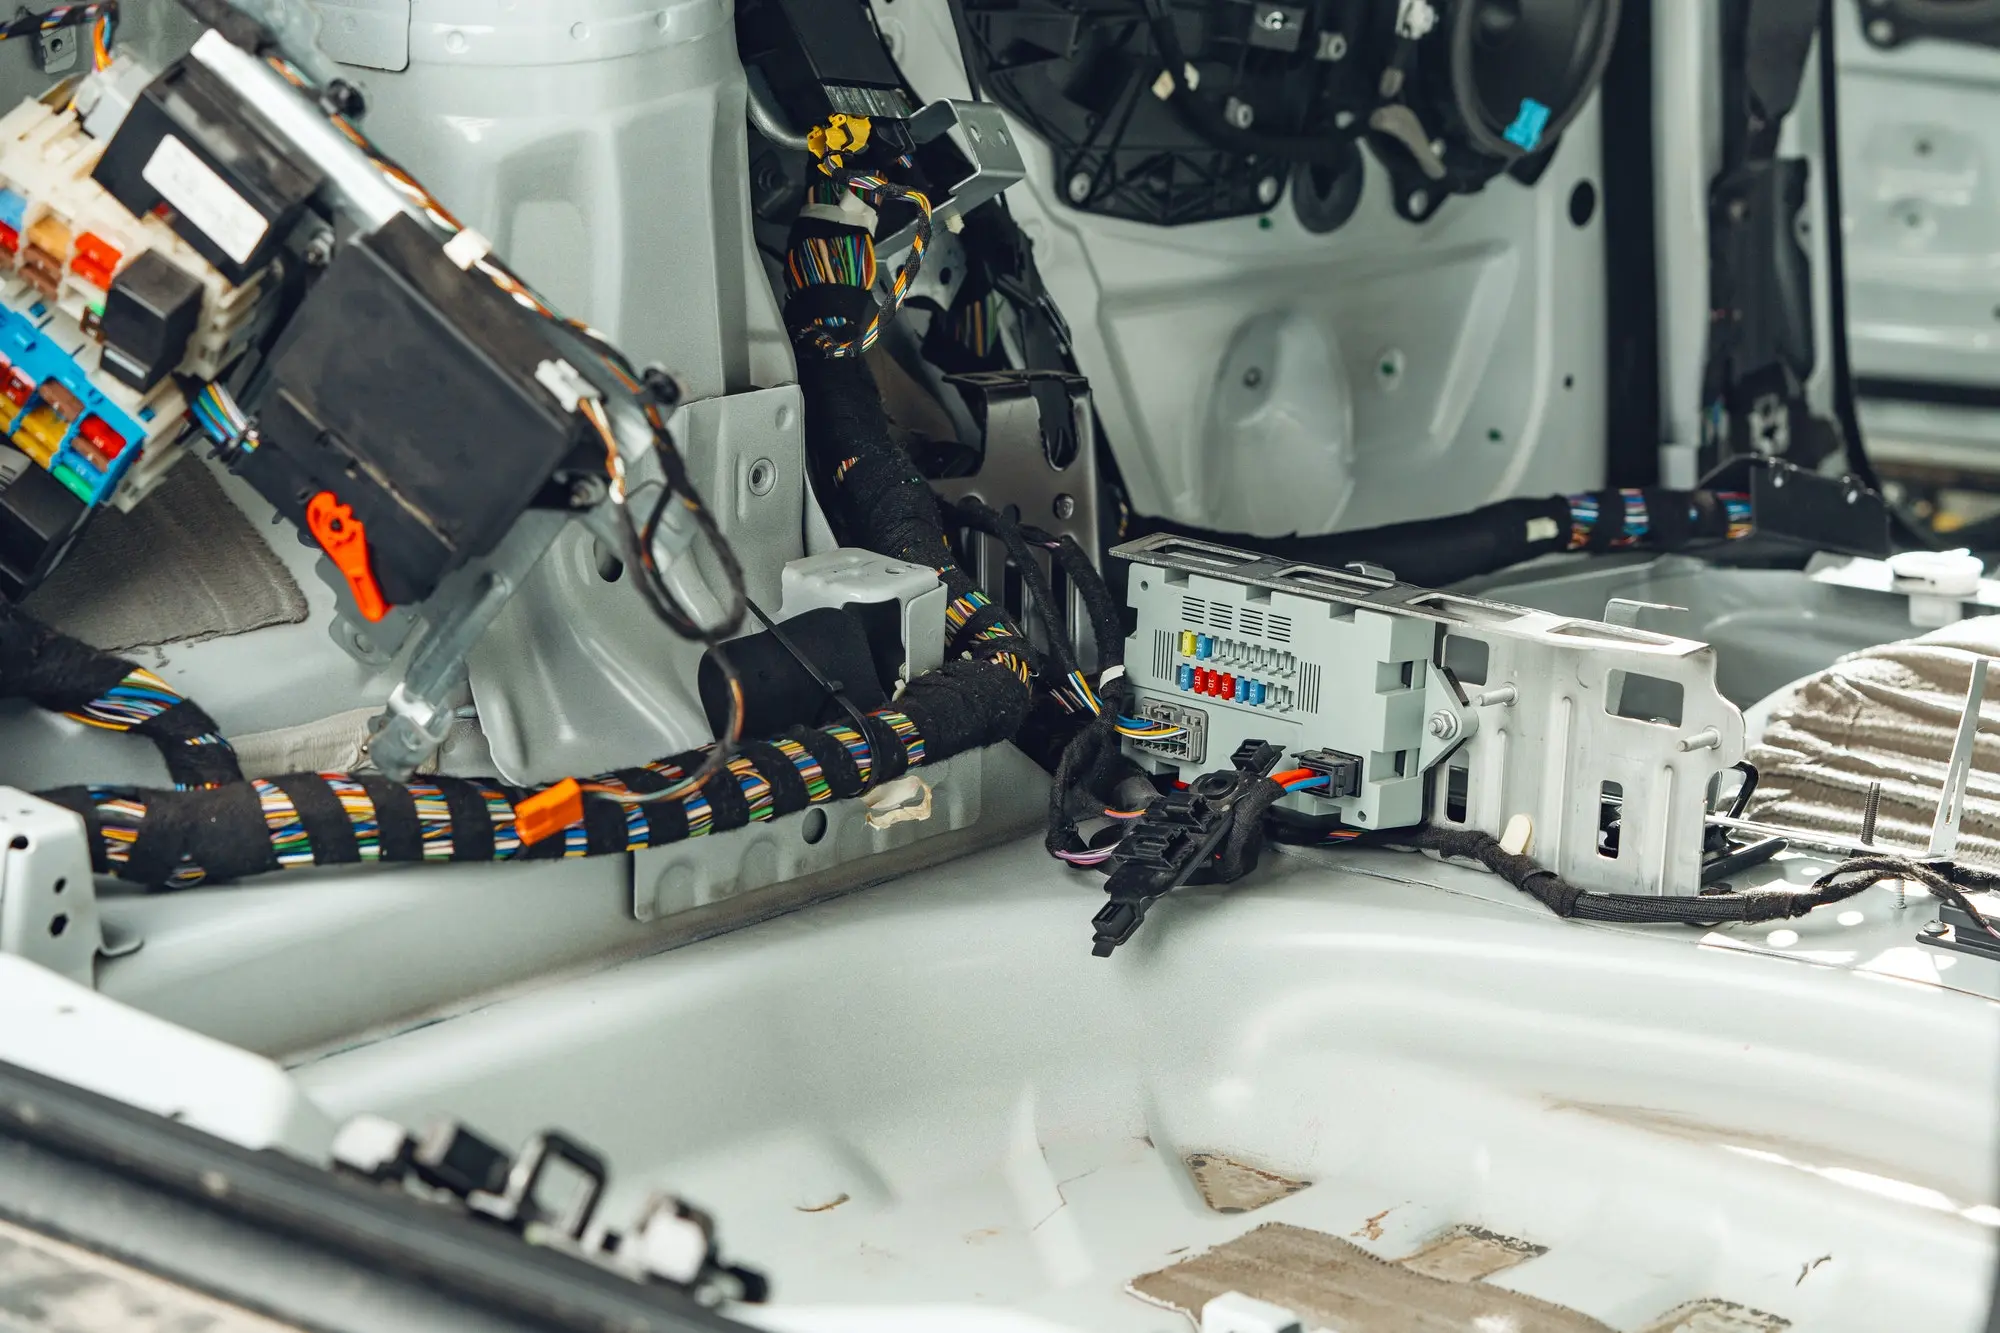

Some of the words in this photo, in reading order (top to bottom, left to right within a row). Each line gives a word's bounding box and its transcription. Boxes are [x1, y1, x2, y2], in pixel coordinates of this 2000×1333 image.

[1194, 675, 1201, 686] 10
[1208, 679, 1214, 688] 10
[1222, 682, 1228, 692] 10
